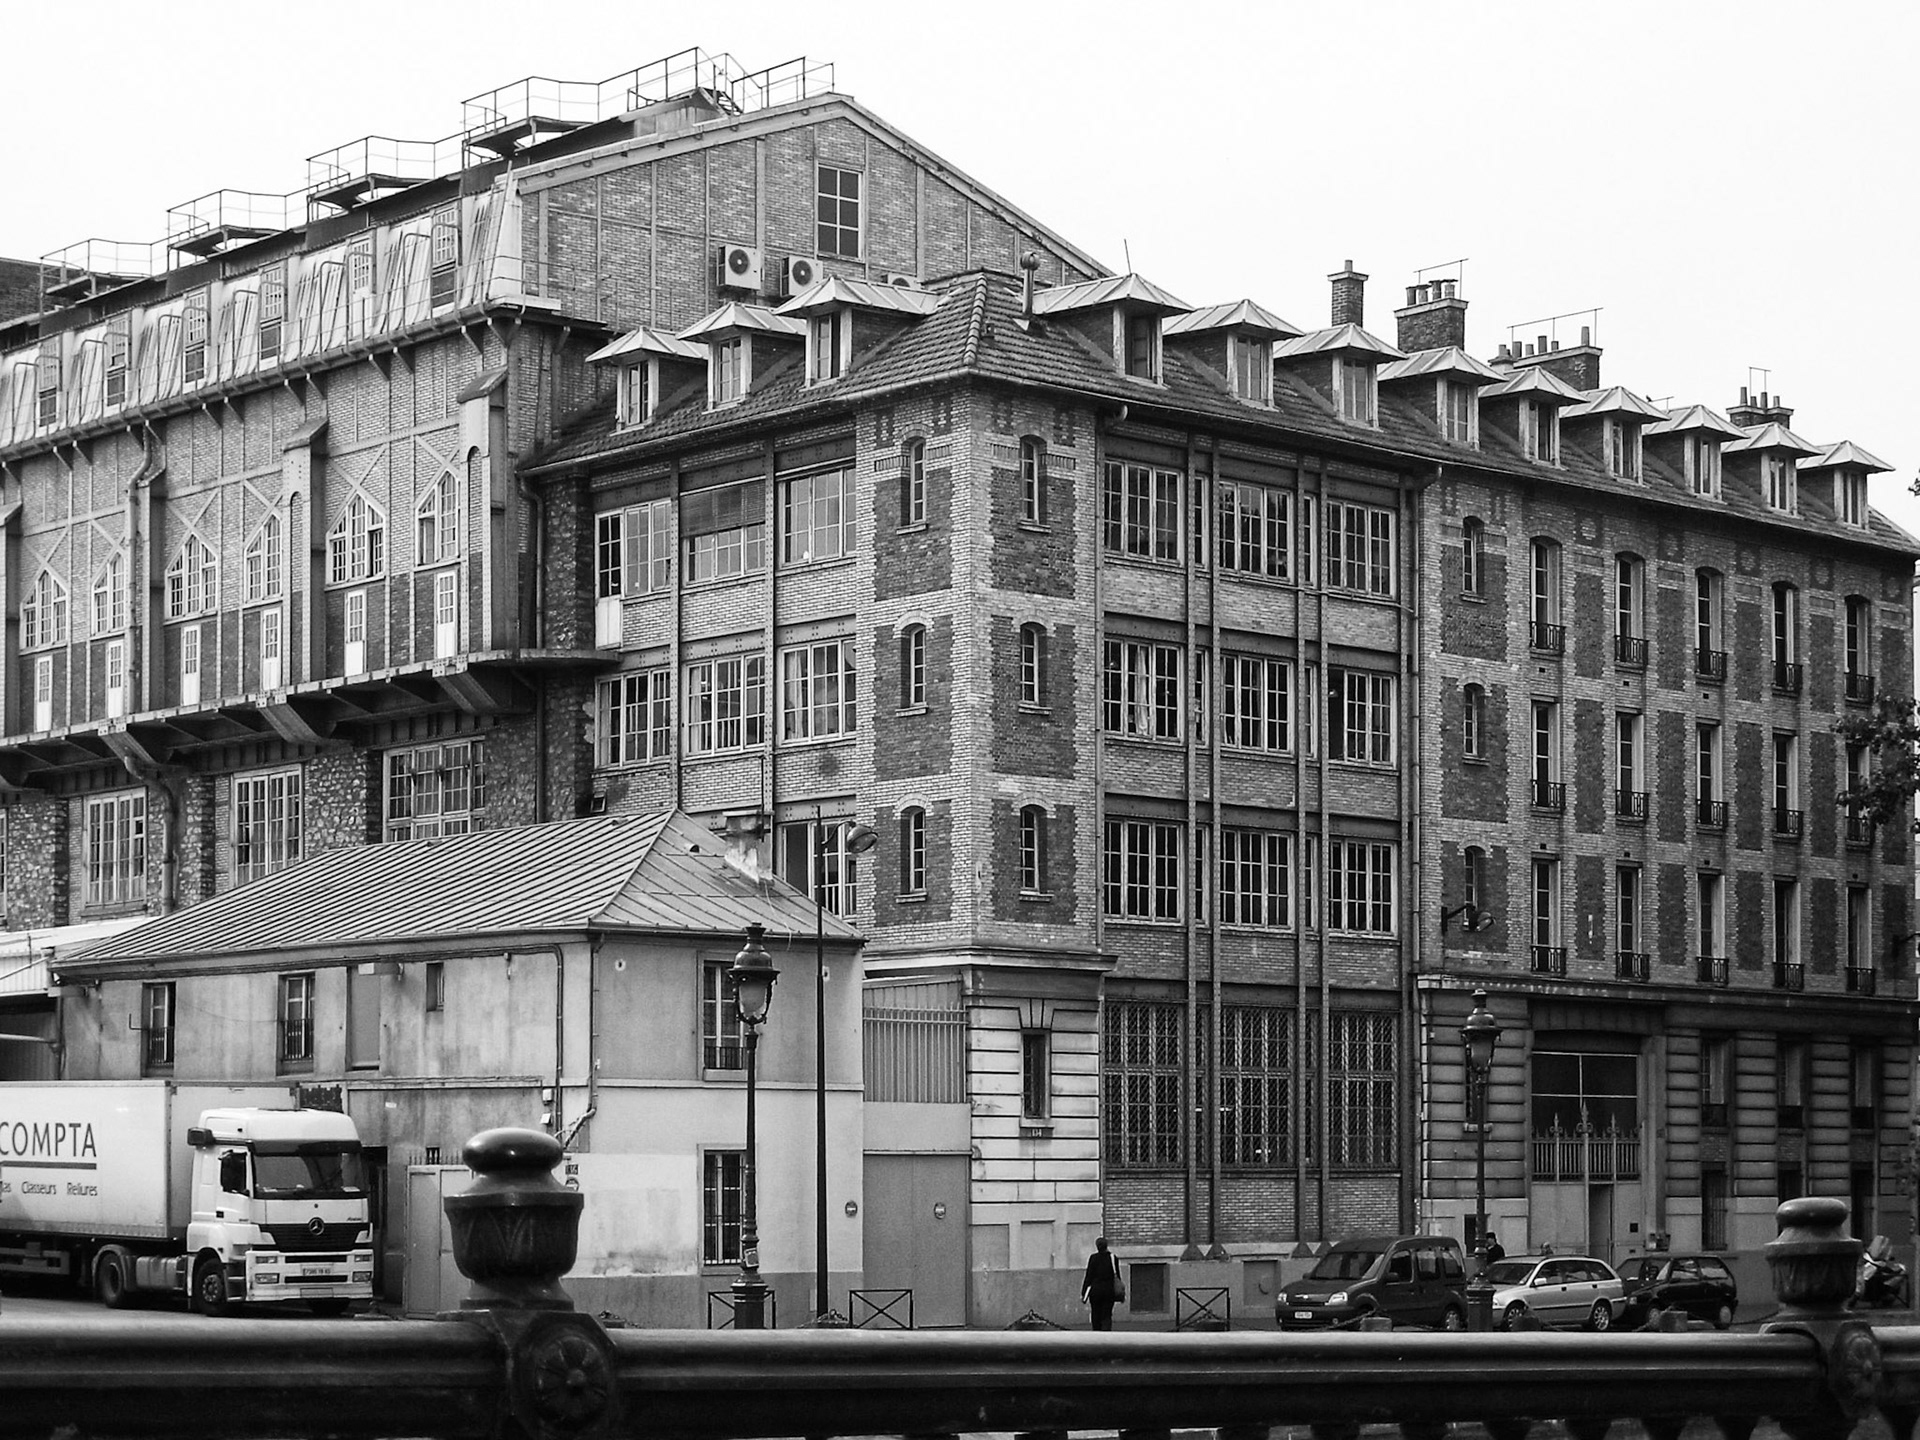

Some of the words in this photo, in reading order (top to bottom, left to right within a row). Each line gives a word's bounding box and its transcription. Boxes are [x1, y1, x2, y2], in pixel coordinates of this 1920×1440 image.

[0, 1122, 97, 1157] COMPTA
[21, 1181, 57, 1195] Classeurs
[67, 1182, 98, 1197] Reliures
